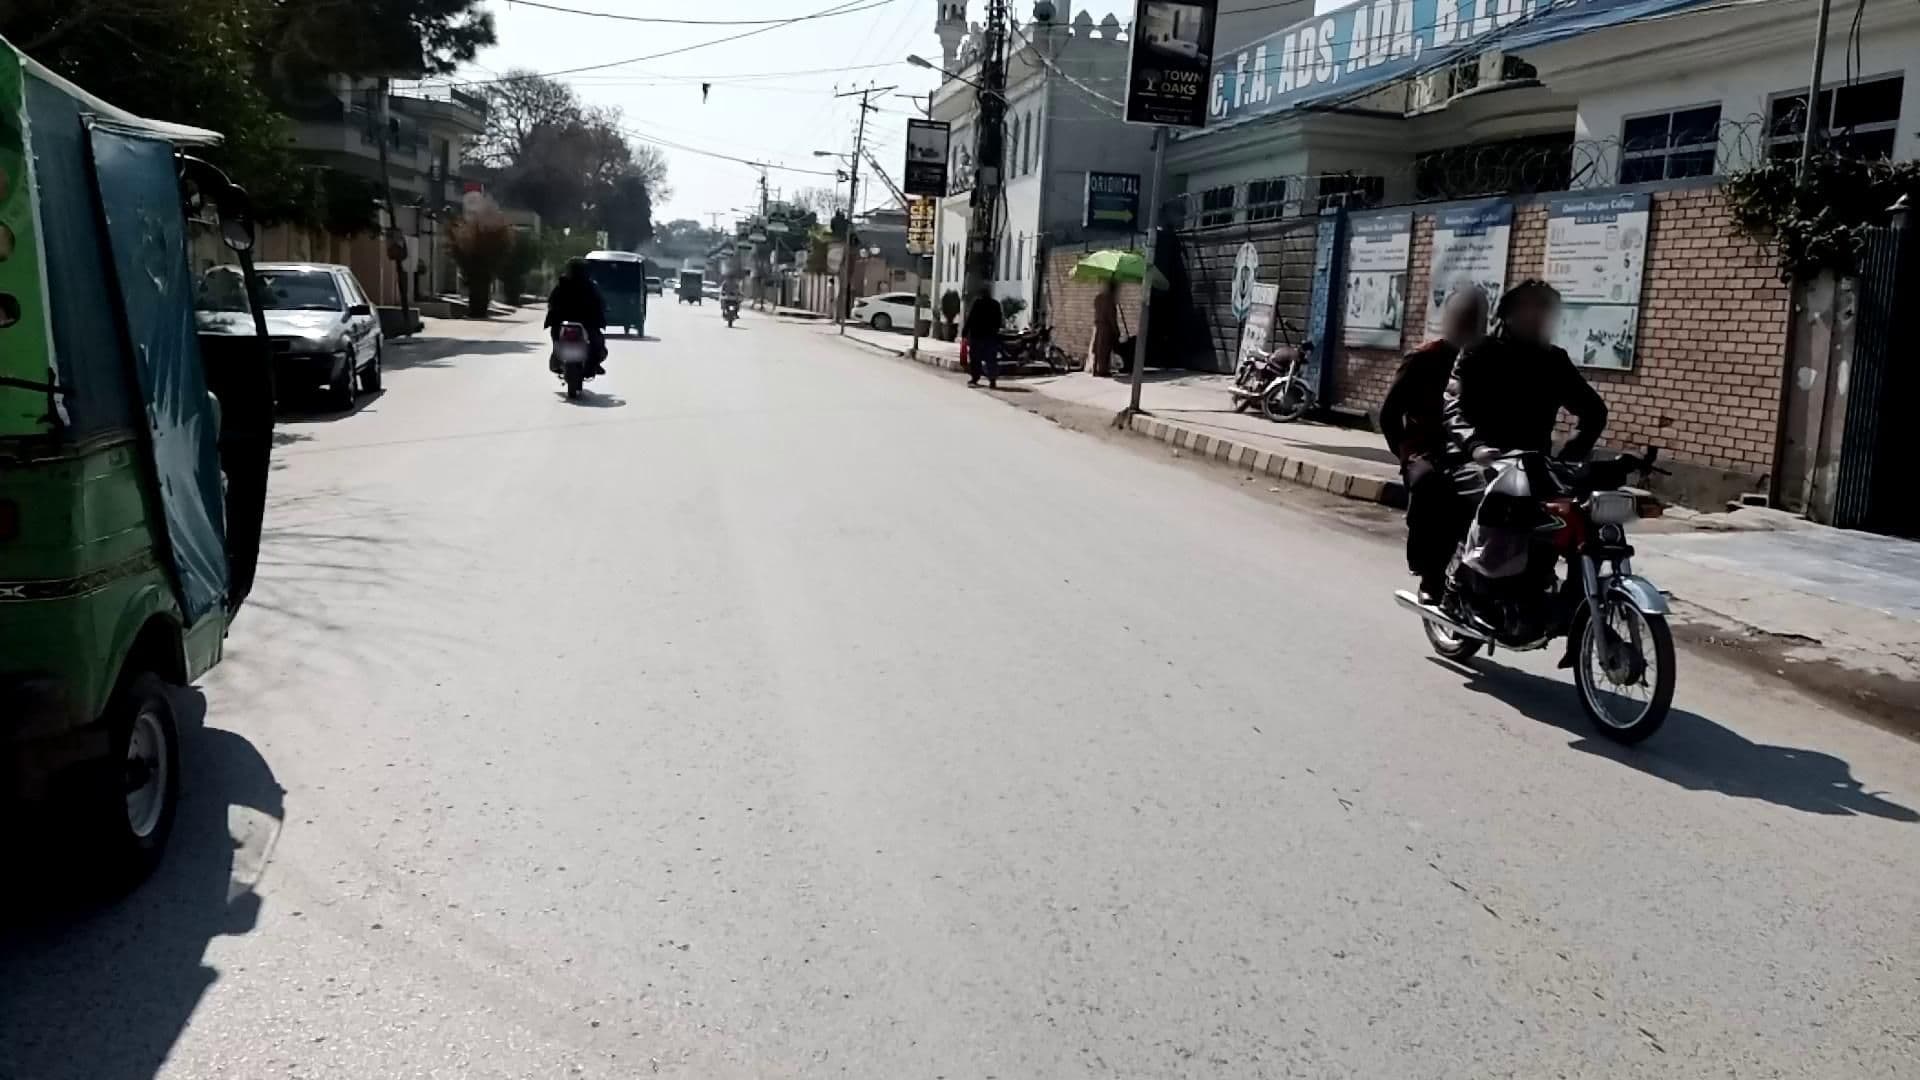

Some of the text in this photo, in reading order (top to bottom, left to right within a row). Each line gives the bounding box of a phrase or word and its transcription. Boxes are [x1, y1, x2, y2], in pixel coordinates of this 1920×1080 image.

[1278, 18, 1340, 94] ADS,
[1346, 0, 1423, 74] ADA,
[1163, 69, 1204, 83] TOWN
[1160, 82, 1198, 96] OAKS
